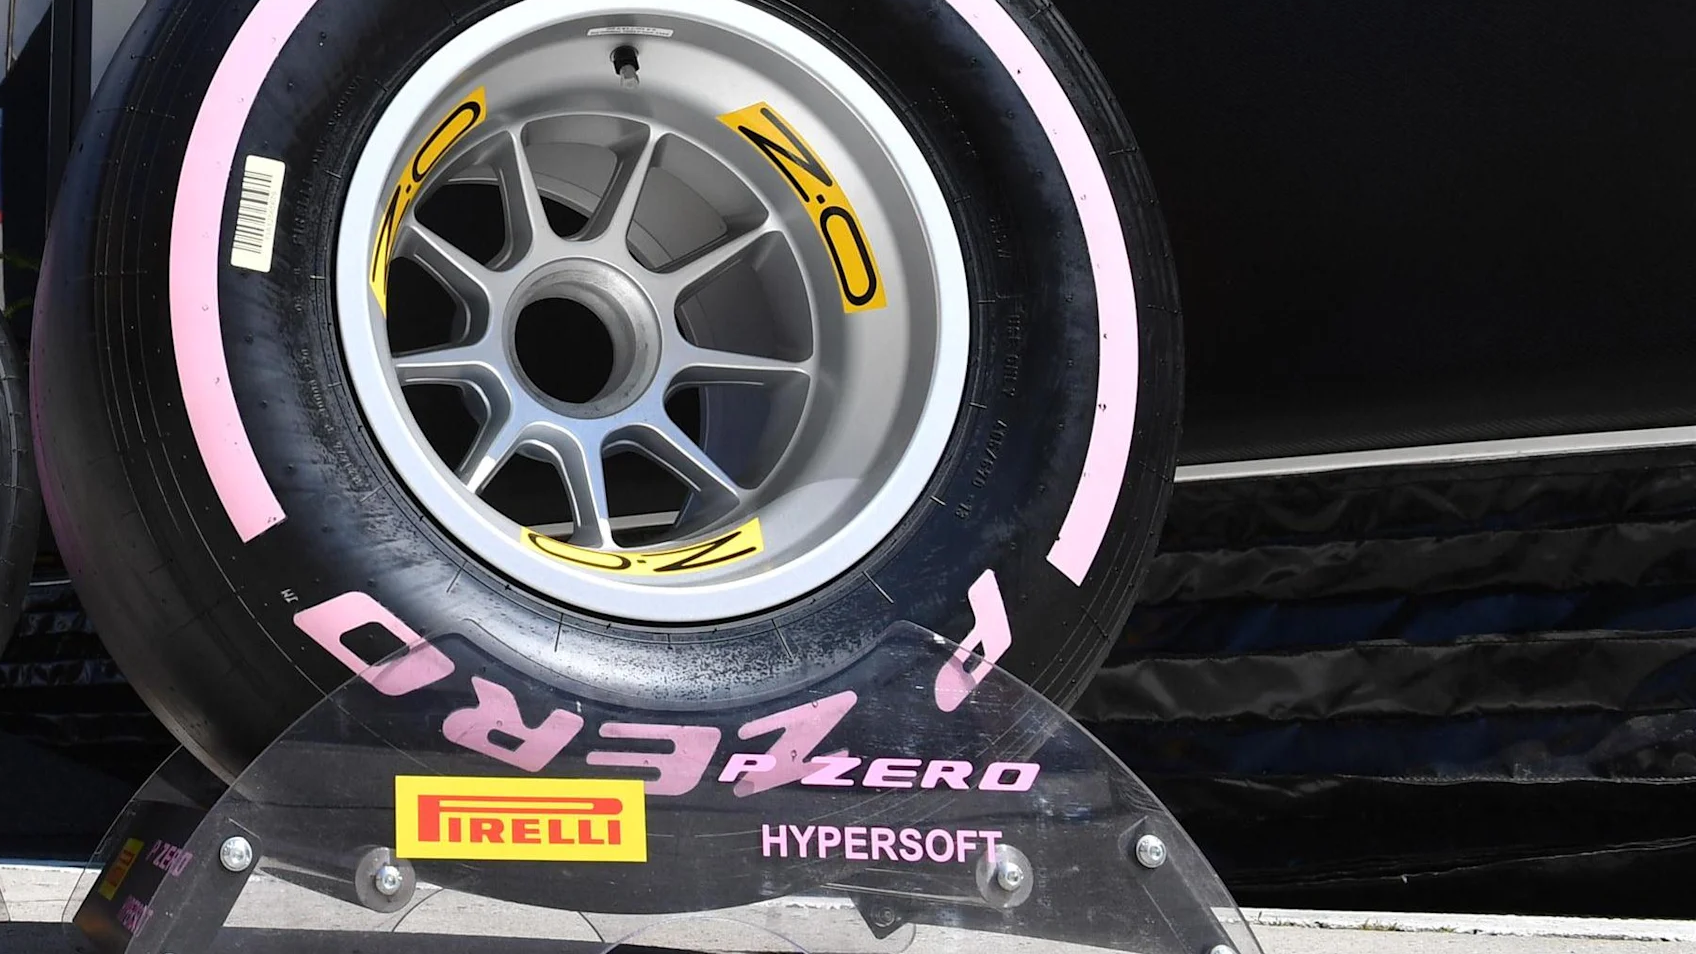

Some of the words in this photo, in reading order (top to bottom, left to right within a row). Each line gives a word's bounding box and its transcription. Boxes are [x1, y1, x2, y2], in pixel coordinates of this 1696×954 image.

[293, 590, 858, 798] ZERO
[718, 753, 778, 784] P
[801, 757, 1041, 792] ZERO
[417, 794, 624, 845] PIRELLI
[761, 824, 1004, 864] HYPERSOFT
